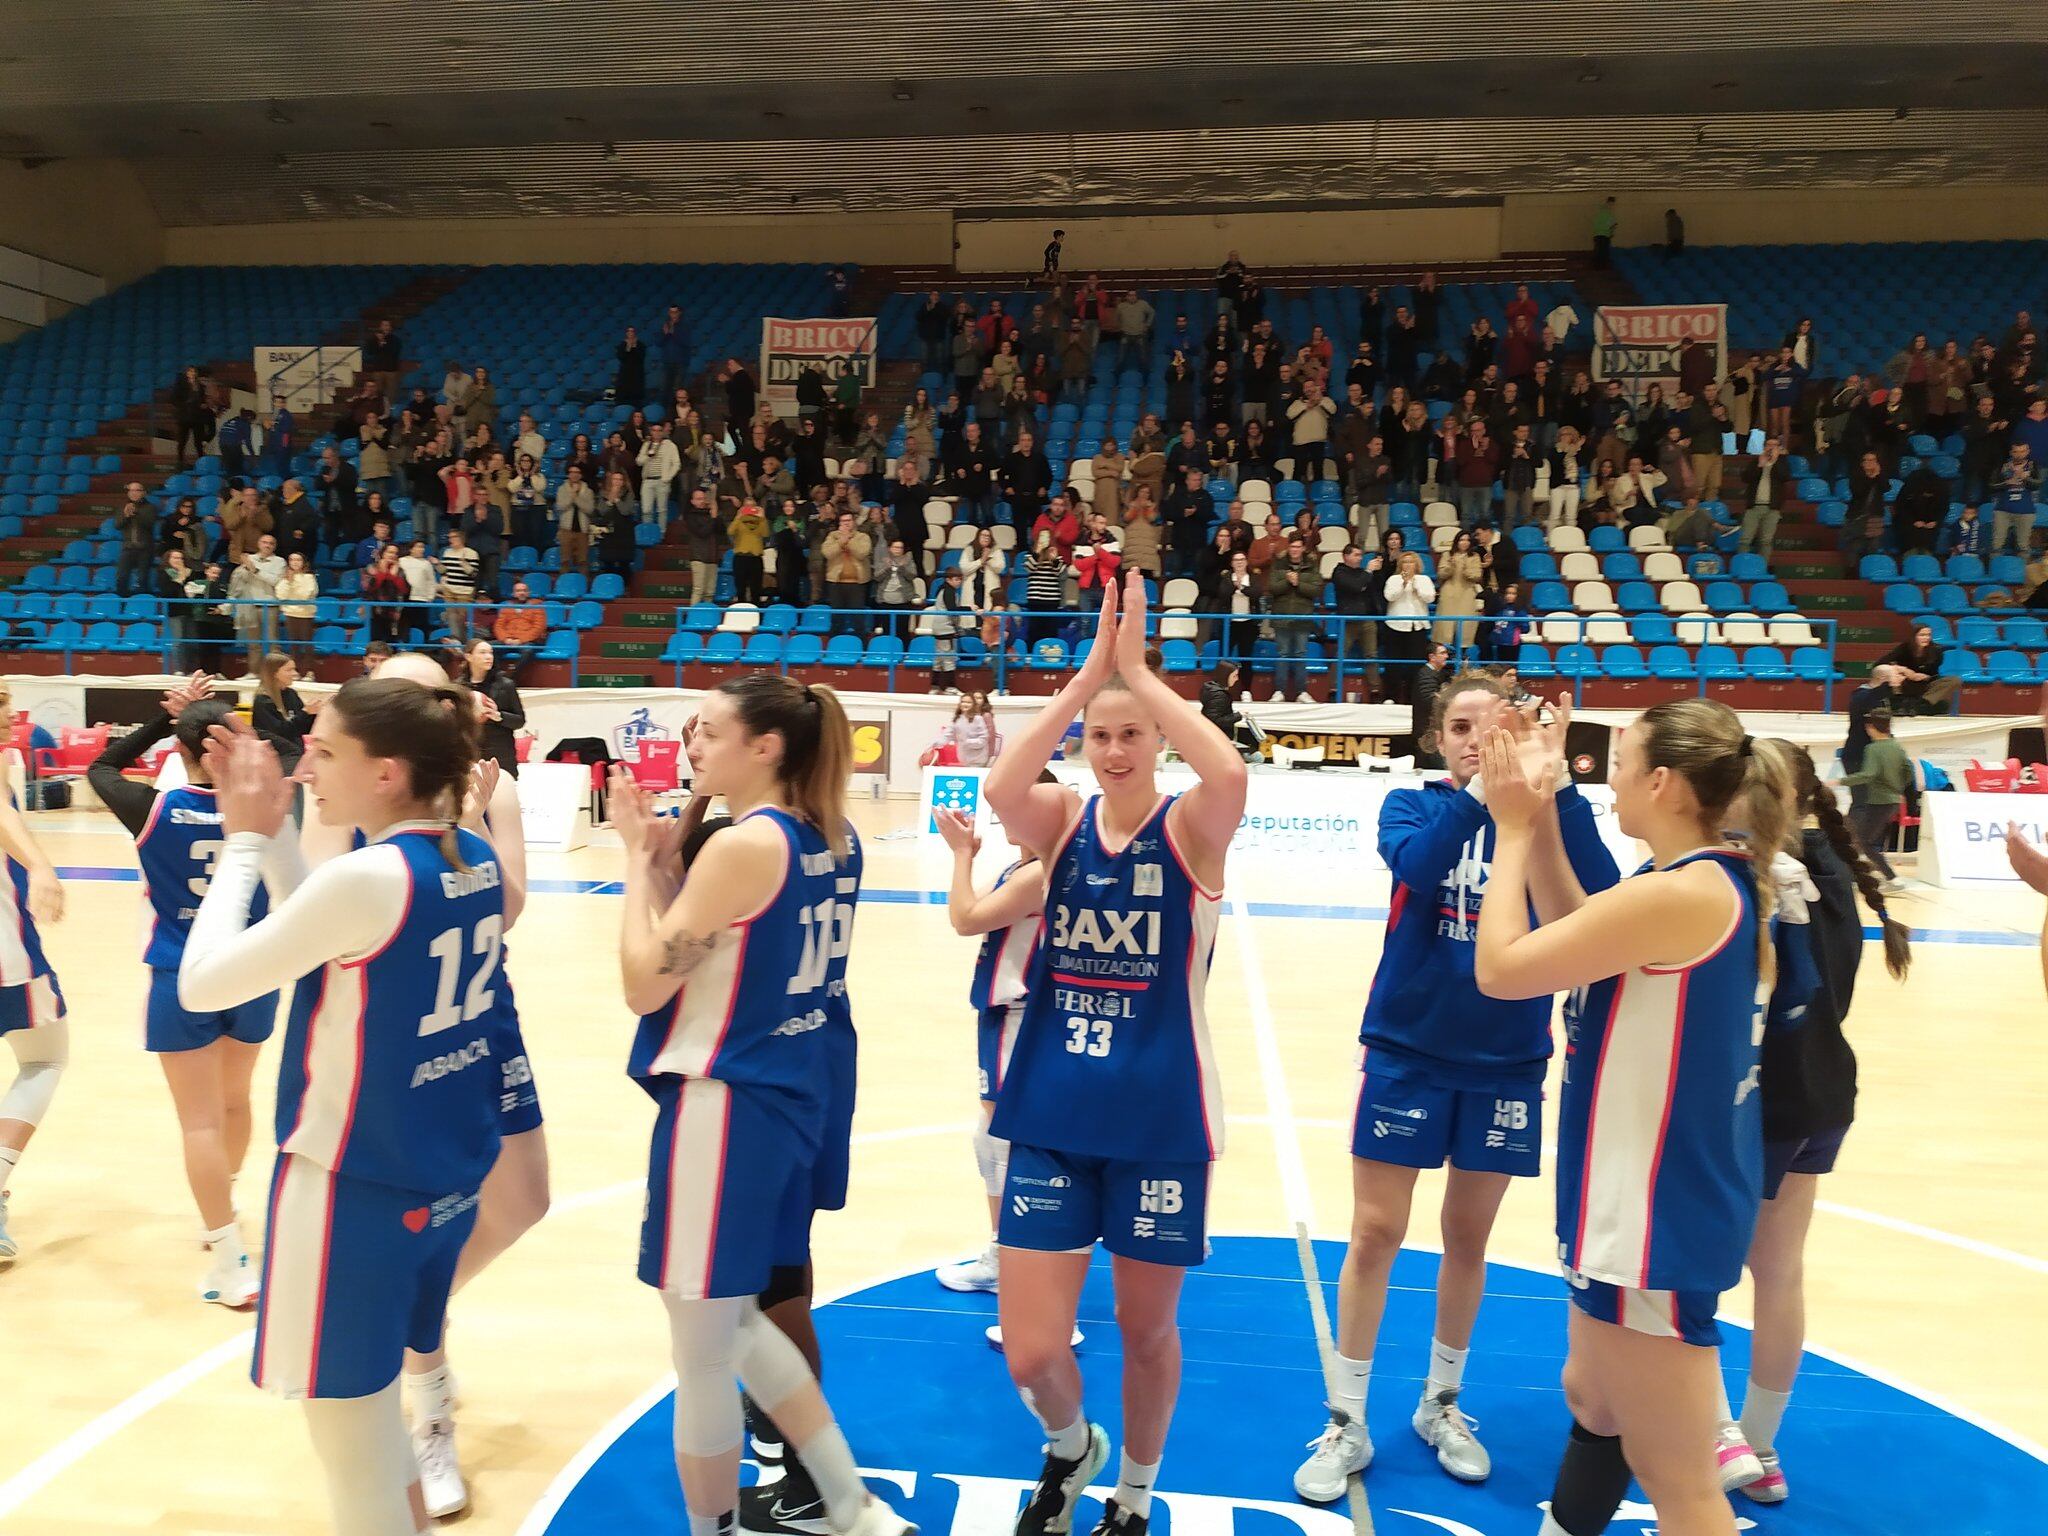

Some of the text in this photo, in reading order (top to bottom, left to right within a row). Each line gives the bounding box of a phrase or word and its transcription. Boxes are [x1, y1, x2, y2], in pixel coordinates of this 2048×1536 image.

[773, 326, 867, 349] BRICO
[1606, 314, 1716, 338] BRICO
[1604, 349, 1715, 373] DEP
[1053, 904, 1161, 956] BAXI
[416, 913, 503, 1038] 12
[1050, 954, 1159, 977] LIMATIZACIÓN
[1065, 1016, 1114, 1058] 33
